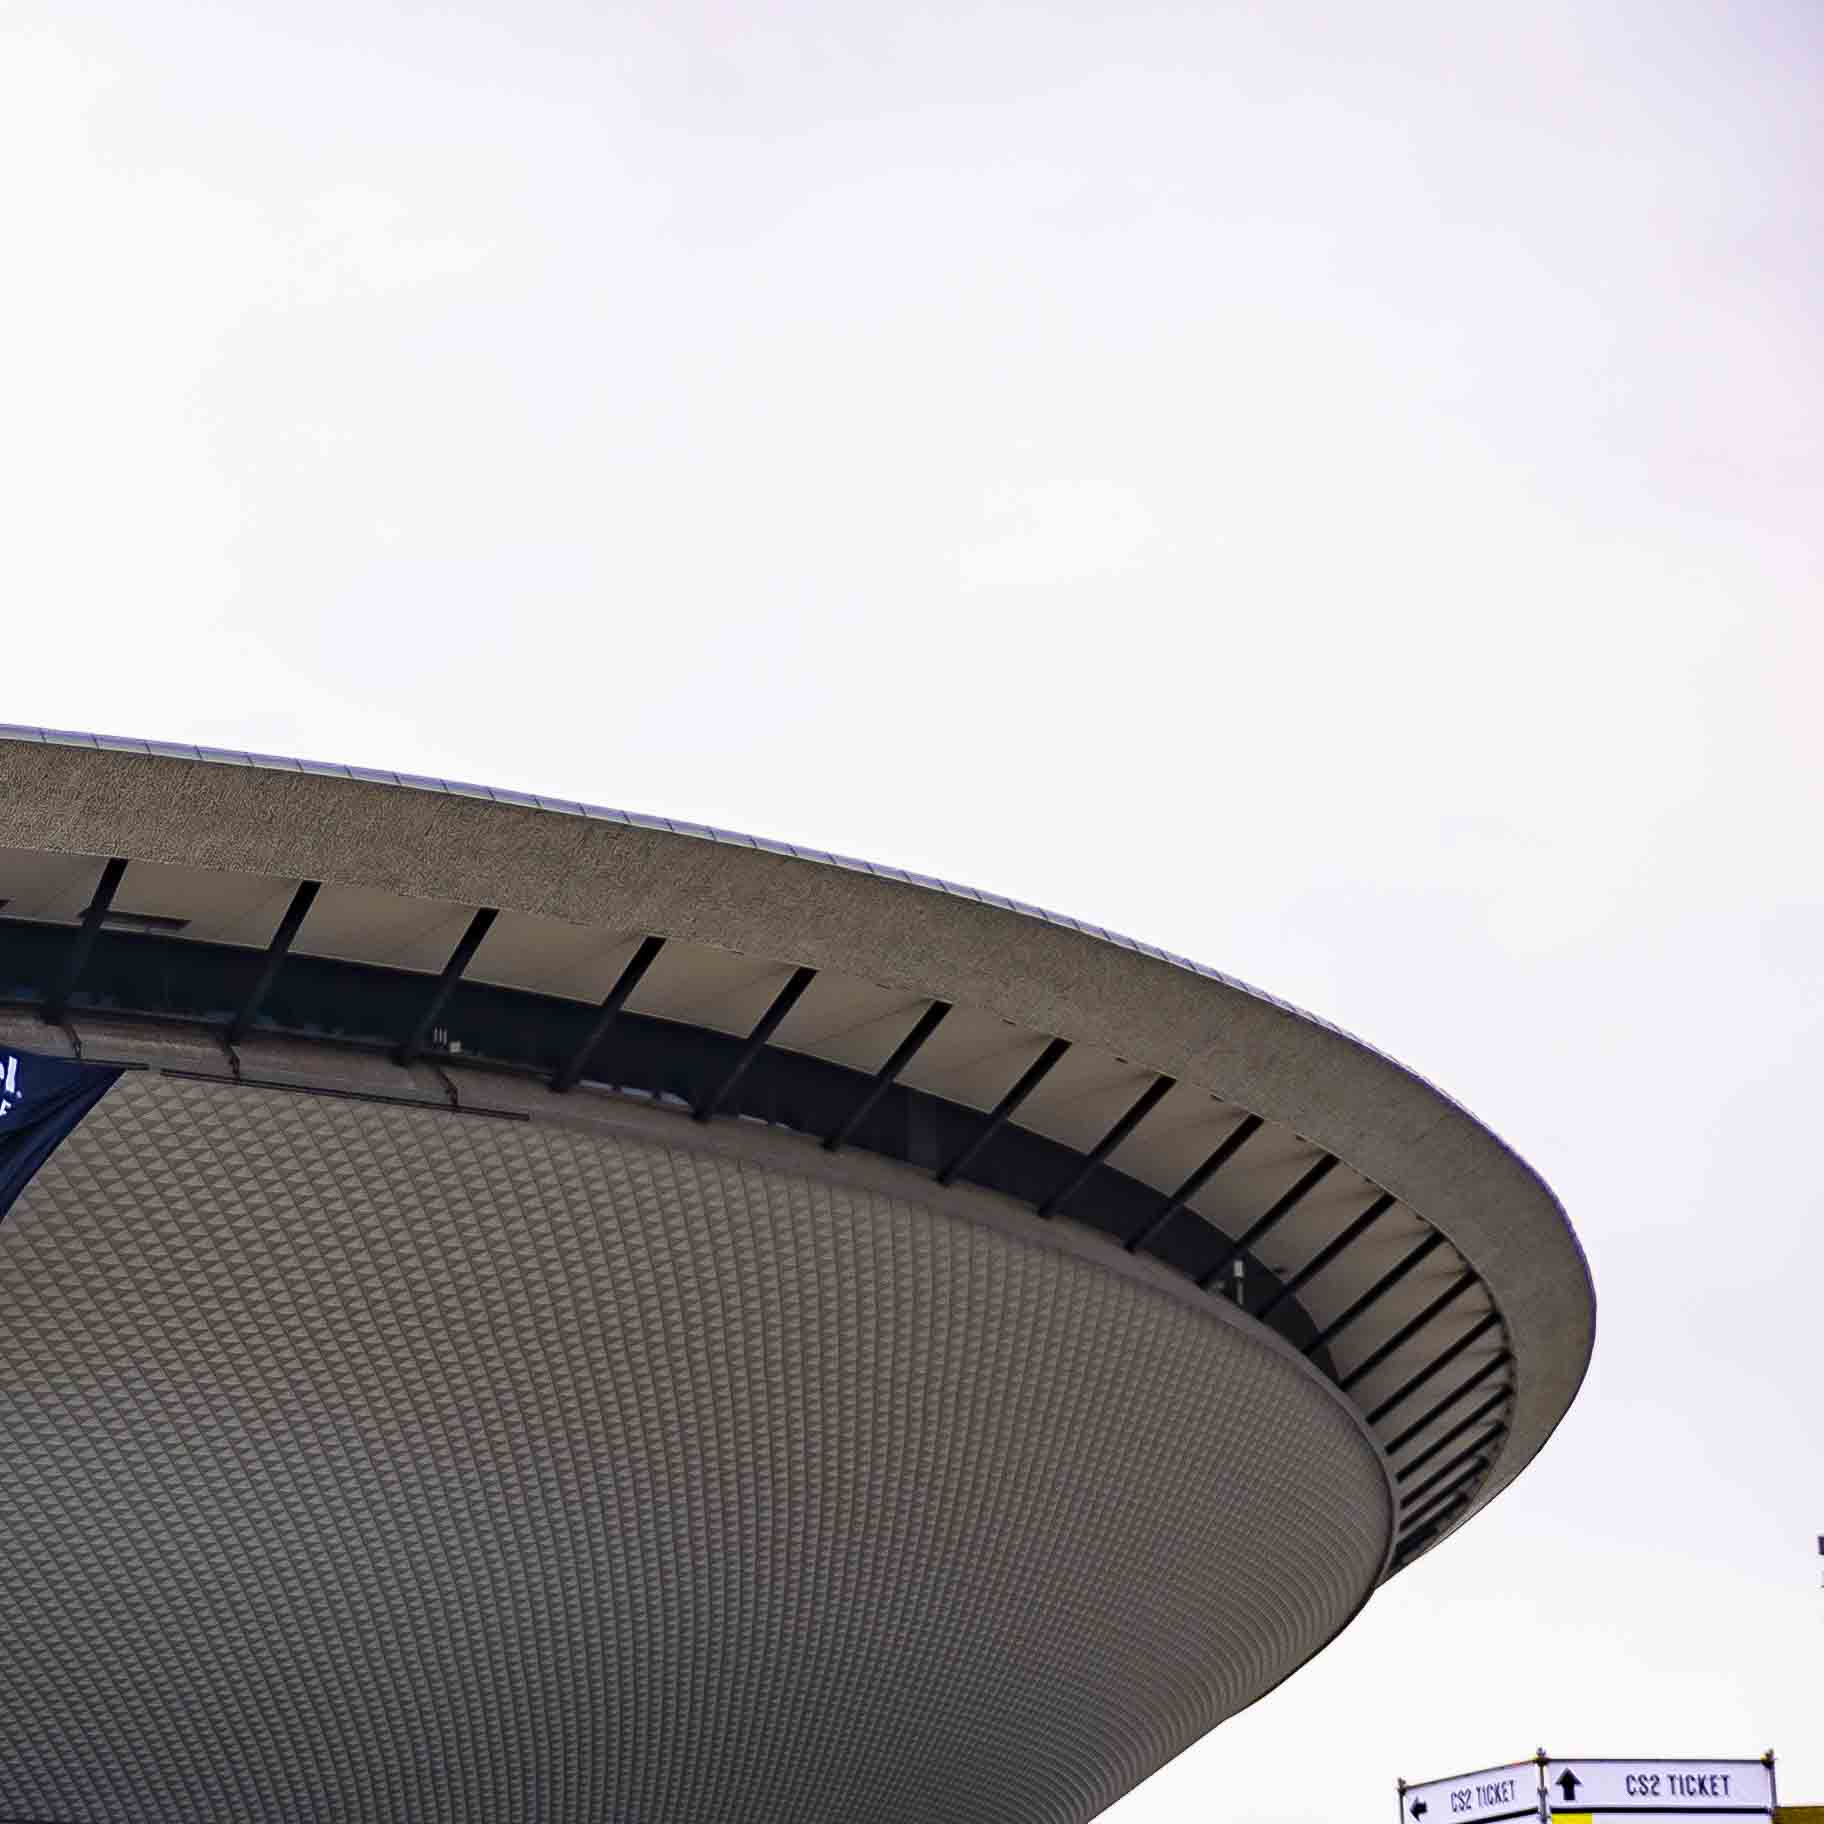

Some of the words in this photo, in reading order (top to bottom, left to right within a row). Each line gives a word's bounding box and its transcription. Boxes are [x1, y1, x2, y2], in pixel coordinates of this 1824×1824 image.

[1450, 1788, 1473, 1813] CS2
[1475, 1779, 1516, 1805] TICKET
[1625, 1774, 1660, 1797] CS2
[1667, 1774, 1732, 1797] TICKET
